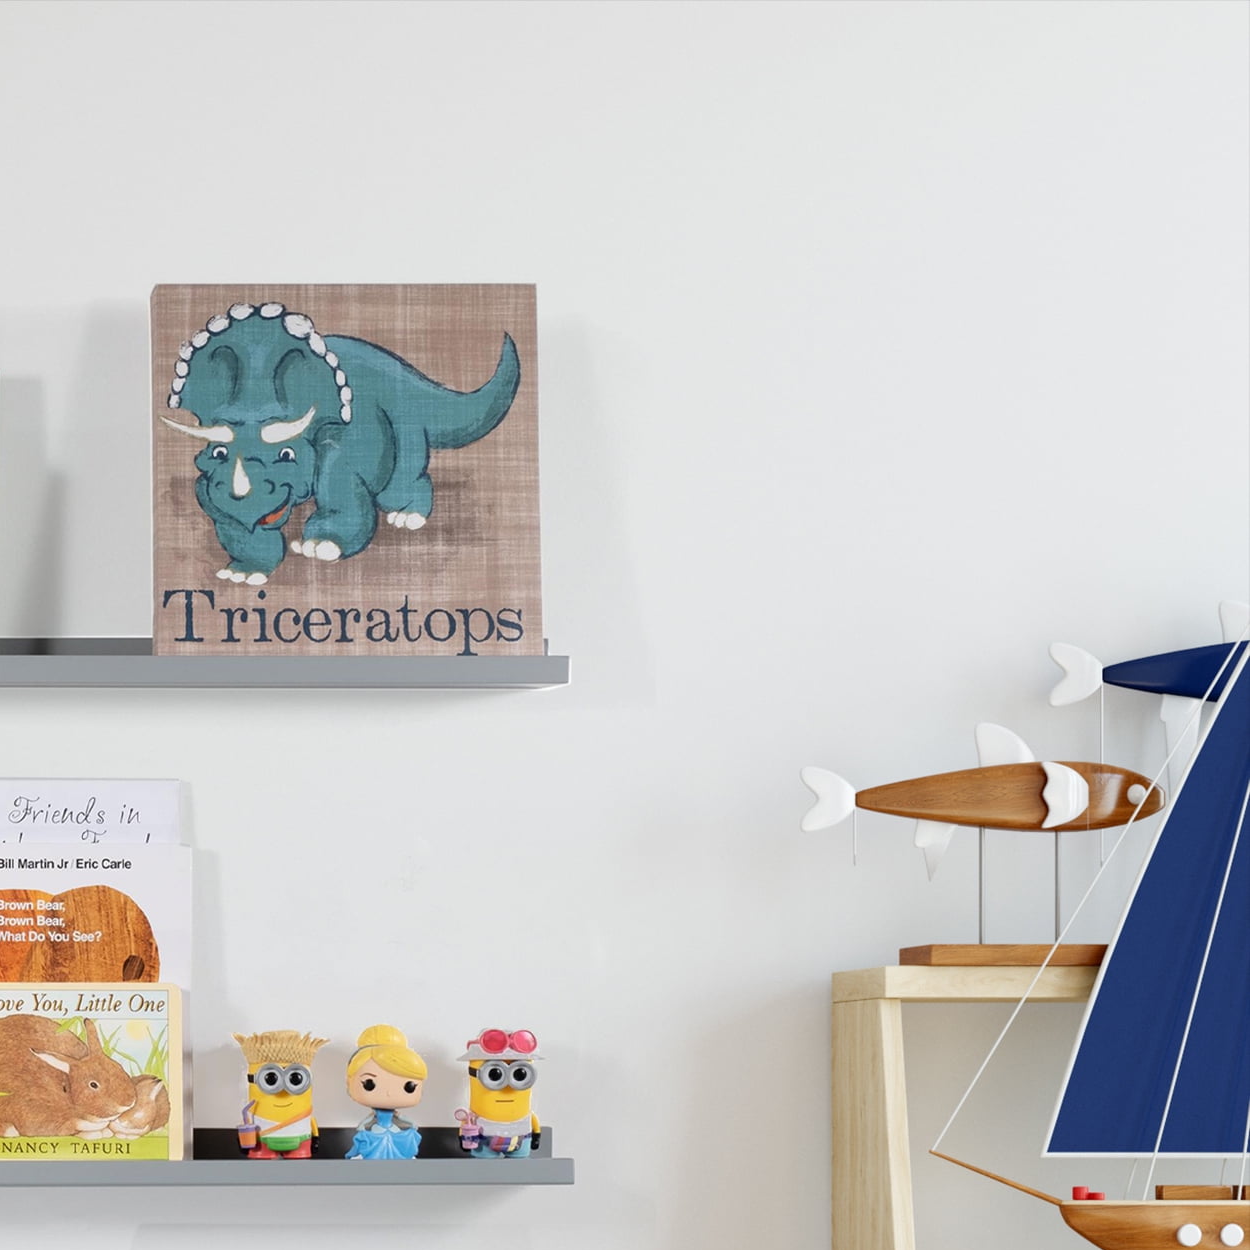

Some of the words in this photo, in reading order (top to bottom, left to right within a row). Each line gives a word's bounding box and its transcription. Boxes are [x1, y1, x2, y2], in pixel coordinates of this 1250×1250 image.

[162, 589, 525, 657] Triceratops
[8, 795, 106, 825] Friends
[119, 803, 142, 824] in
[17, 858, 55, 869] Martin
[56, 858, 69, 869] Jr
[76, 858, 99, 869] Eric
[101, 858, 132, 869] Carle
[36, 899, 66, 913] Bear,
[36, 915, 66, 928] Bear,
[28, 931, 45, 942] Do
[48, 931, 70, 942] You
[72, 930, 102, 942] See?
[32, 993, 69, 1015] You,
[75, 993, 122, 1013] Little
[129, 993, 166, 1013] One
[0, 1142, 59, 1154] NANCY
[70, 1142, 132, 1155] TAFURI
